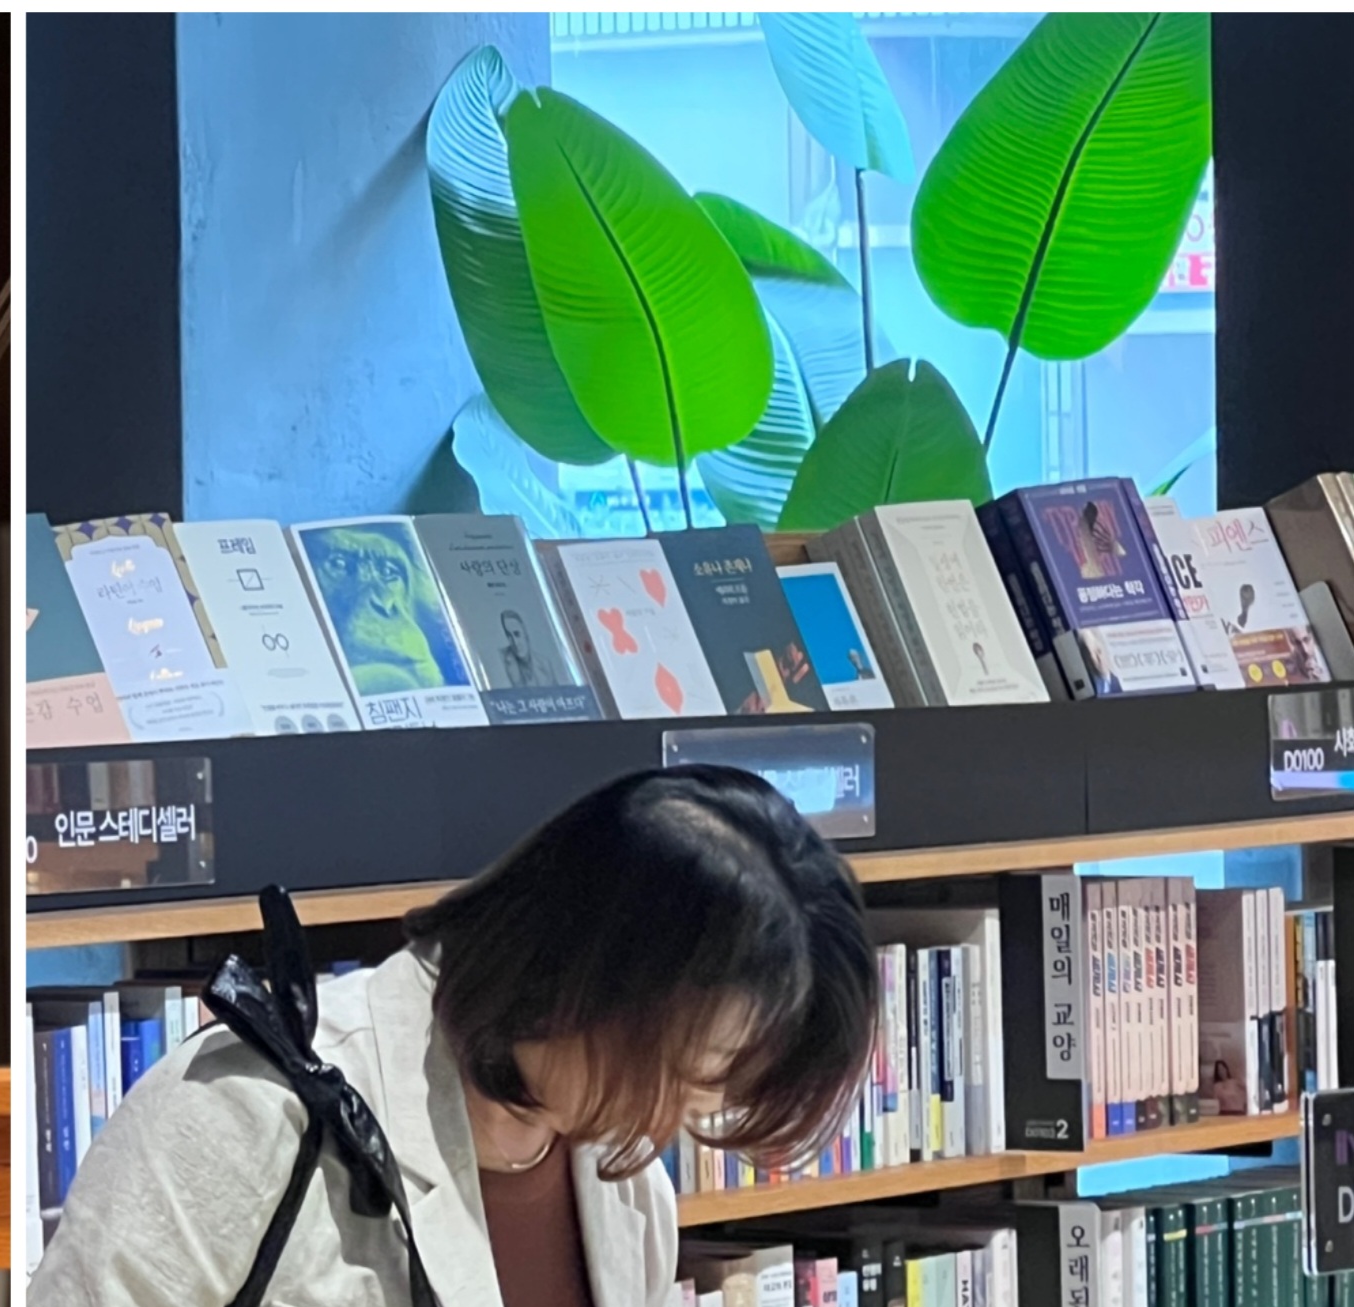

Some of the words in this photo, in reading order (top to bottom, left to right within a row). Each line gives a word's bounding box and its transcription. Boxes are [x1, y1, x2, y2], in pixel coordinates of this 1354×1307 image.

[217, 537, 256, 555] 프레임
[1195, 518, 1270, 553] 피엔스
[67, 691, 103, 715] 수업
[365, 697, 422, 725] 침팬지
[1284, 747, 1324, 772] D0100
[55, 810, 96, 848] 인문
[98, 804, 196, 845] 스테디셀러
[1049, 892, 1072, 986] 매일의
[1052, 1003, 1076, 1062] 교양
[1056, 1120, 1069, 1139] 2
